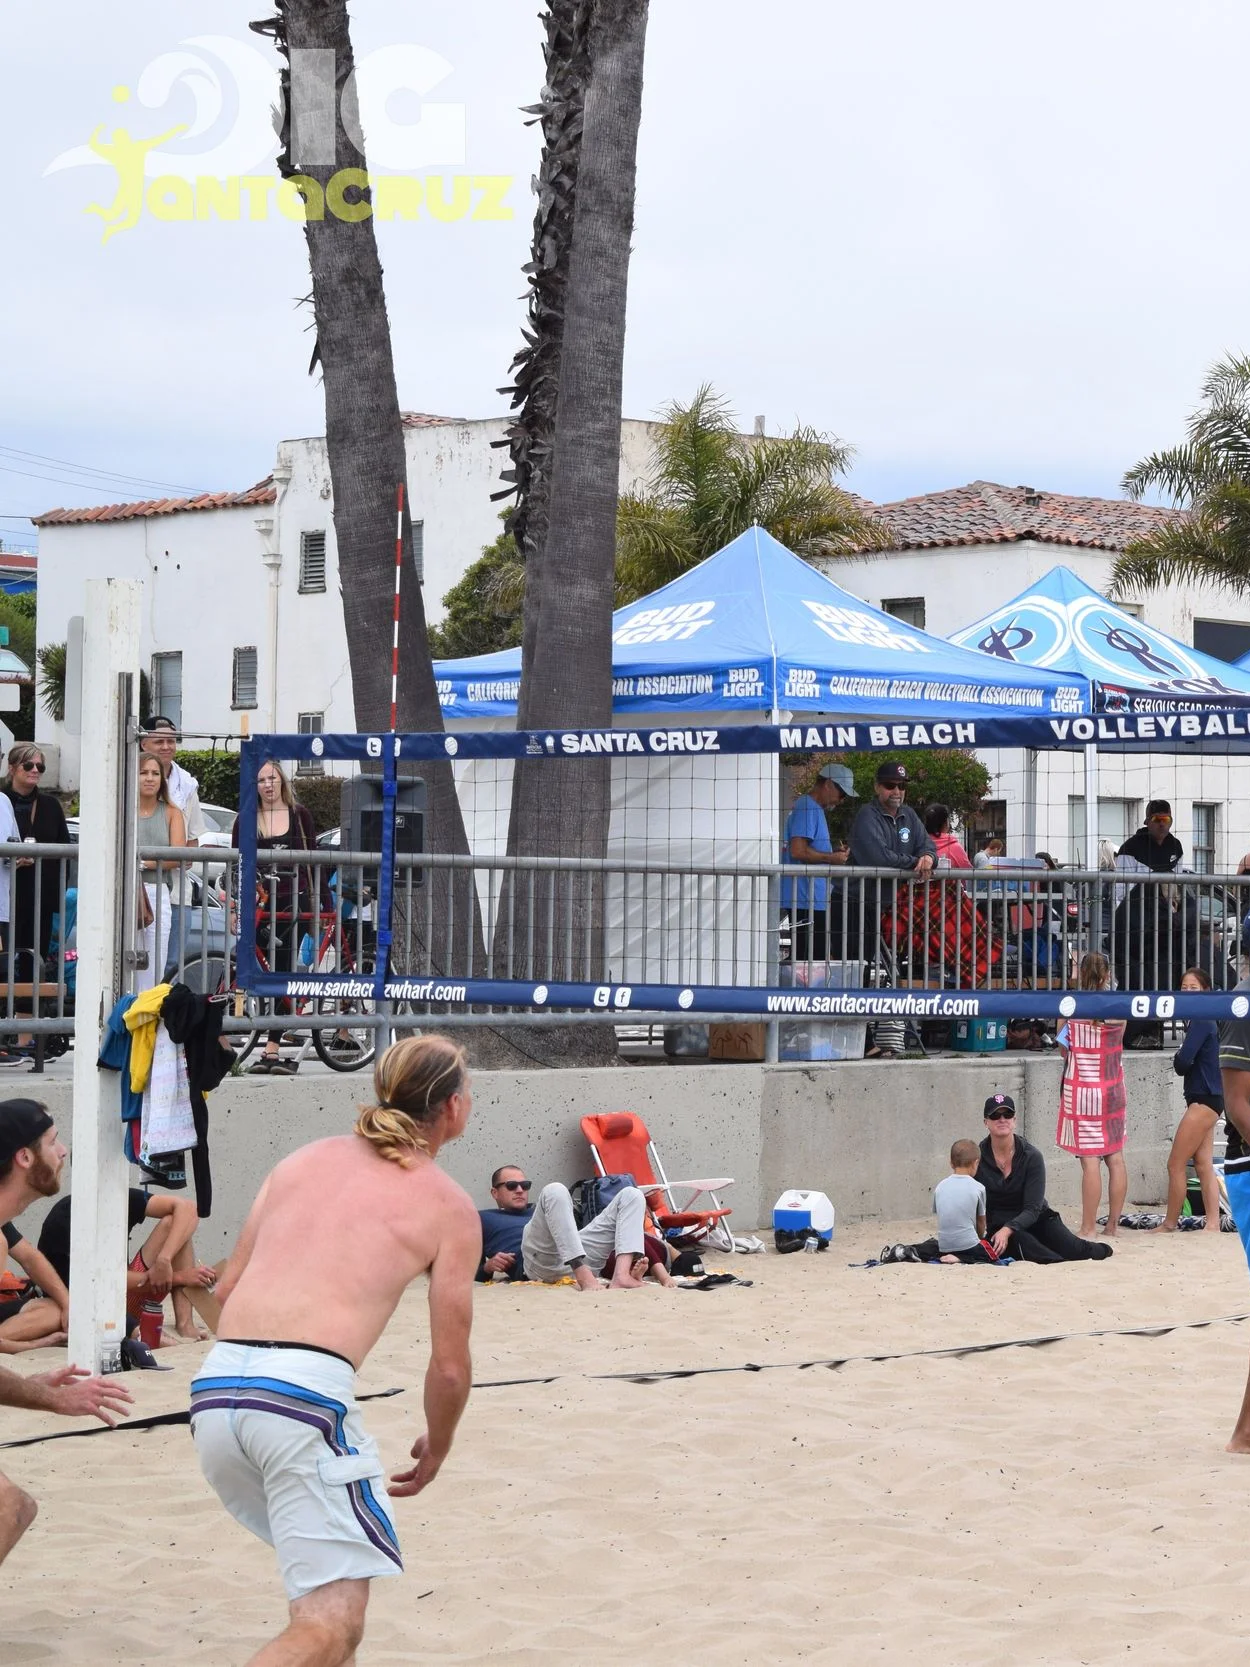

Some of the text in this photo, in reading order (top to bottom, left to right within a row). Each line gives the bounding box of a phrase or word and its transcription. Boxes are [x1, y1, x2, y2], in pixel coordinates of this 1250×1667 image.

[619, 601, 716, 630] BUD
[800, 600, 889, 633] BUD
[612, 620, 716, 645] IGHT
[813, 620, 933, 654] LIGHT
[637, 675, 713, 696] ASSOCIATION
[728, 668, 760, 683] BUD
[789, 668, 817, 683] BUD
[467, 681, 521, 702] CALIFORN
[723, 682, 765, 697] LIGHT
[785, 682, 821, 698] LIGHT
[830, 676, 1044, 707] CALIFORNIA BEACH VOLLEYBALL ASSOCIATION
[1055, 686, 1080, 700] BUD
[1051, 699, 1084, 713] LIGHT
[562, 733, 644, 753] SANTA
[649, 731, 720, 751] CRUZ
[780, 723, 975, 747] MAIN BEACH
[287, 979, 466, 1001] www.santacrzwharf.com
[767, 993, 979, 1016] www.santacruzwharf.com
